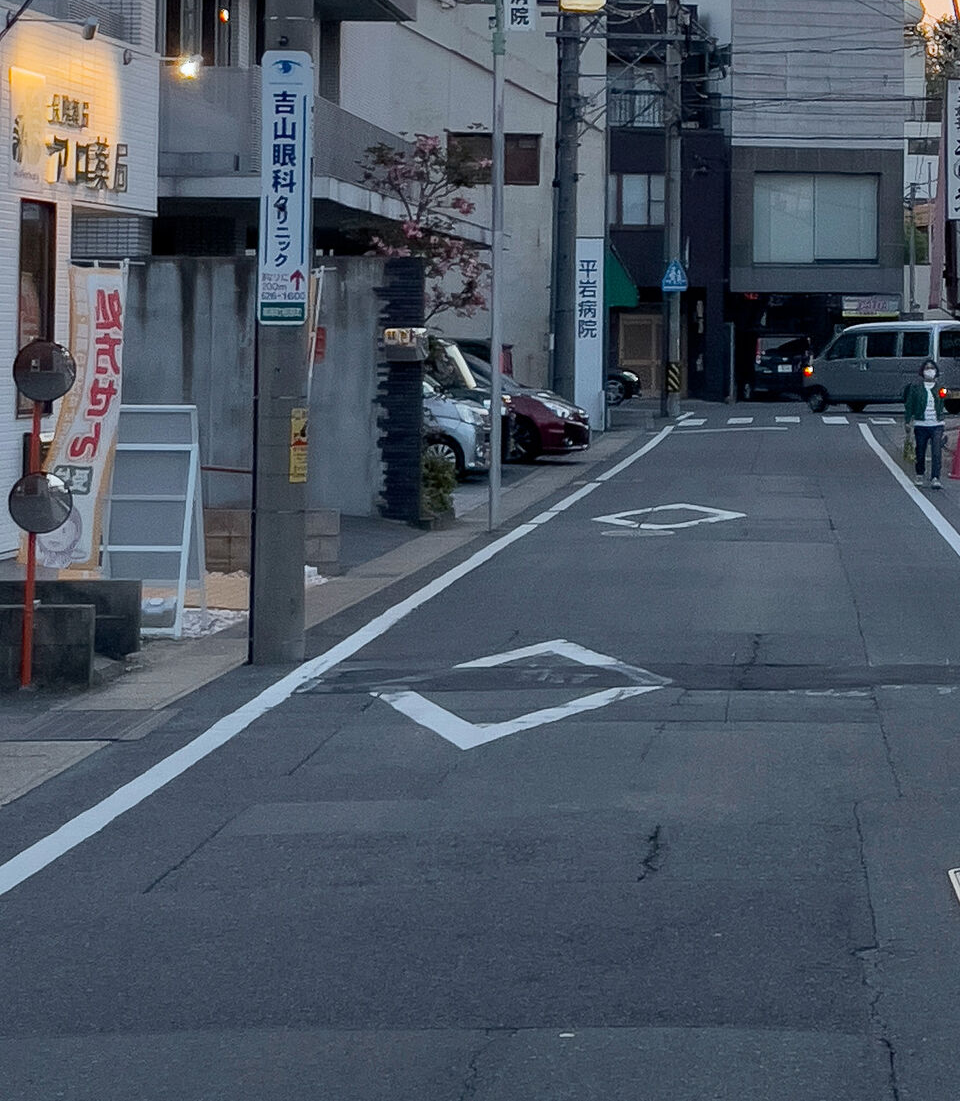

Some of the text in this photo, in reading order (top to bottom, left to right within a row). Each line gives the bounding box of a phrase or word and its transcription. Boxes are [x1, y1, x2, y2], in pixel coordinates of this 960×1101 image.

[272, 90, 297, 267] 吉山眼科クリニック
[578, 260, 597, 338] 平岩病院
